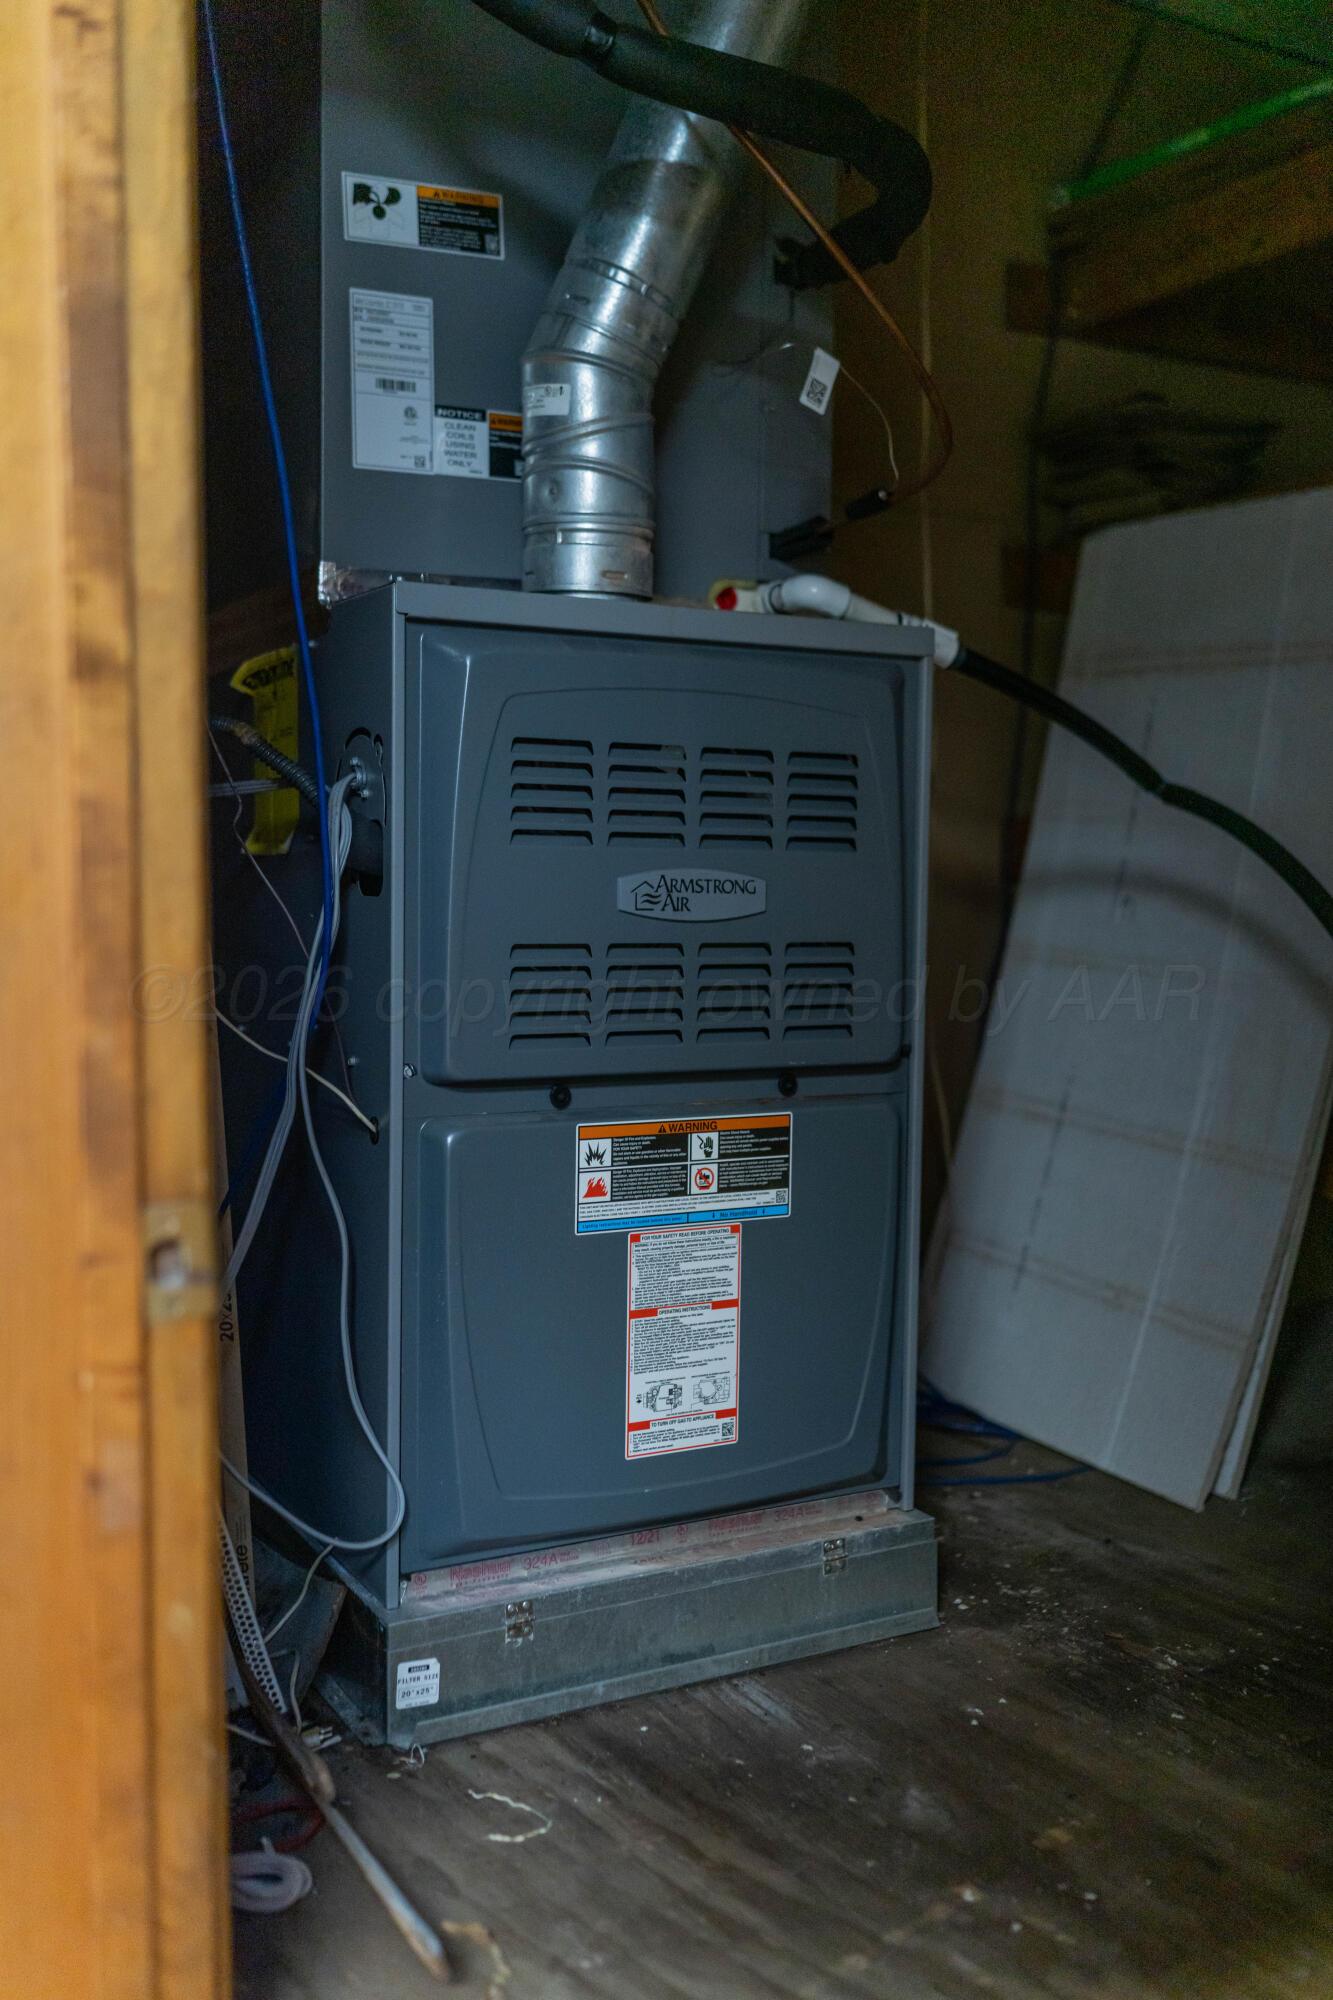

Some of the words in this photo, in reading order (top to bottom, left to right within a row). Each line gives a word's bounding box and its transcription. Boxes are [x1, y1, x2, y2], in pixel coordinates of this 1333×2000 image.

[437, 407, 483, 421] NOTICE
[444, 421, 477, 432] CLEAN
[446, 431, 475, 441] COILS
[445, 441, 476, 451] USING
[443, 450, 478, 459] WATER
[447, 459, 473, 468] ONLY
[655, 874, 758, 895] ARMSTRONG
[660, 893, 691, 912] AIR
[668, 1121, 718, 1132] WARNING
[682, 1305, 711, 1313] INSTRUCTIONS
[693, 1414, 714, 1422] APPLIANCE
[524, 1552, 558, 1570] 324A
[397, 1675, 421, 1685] FILTER
